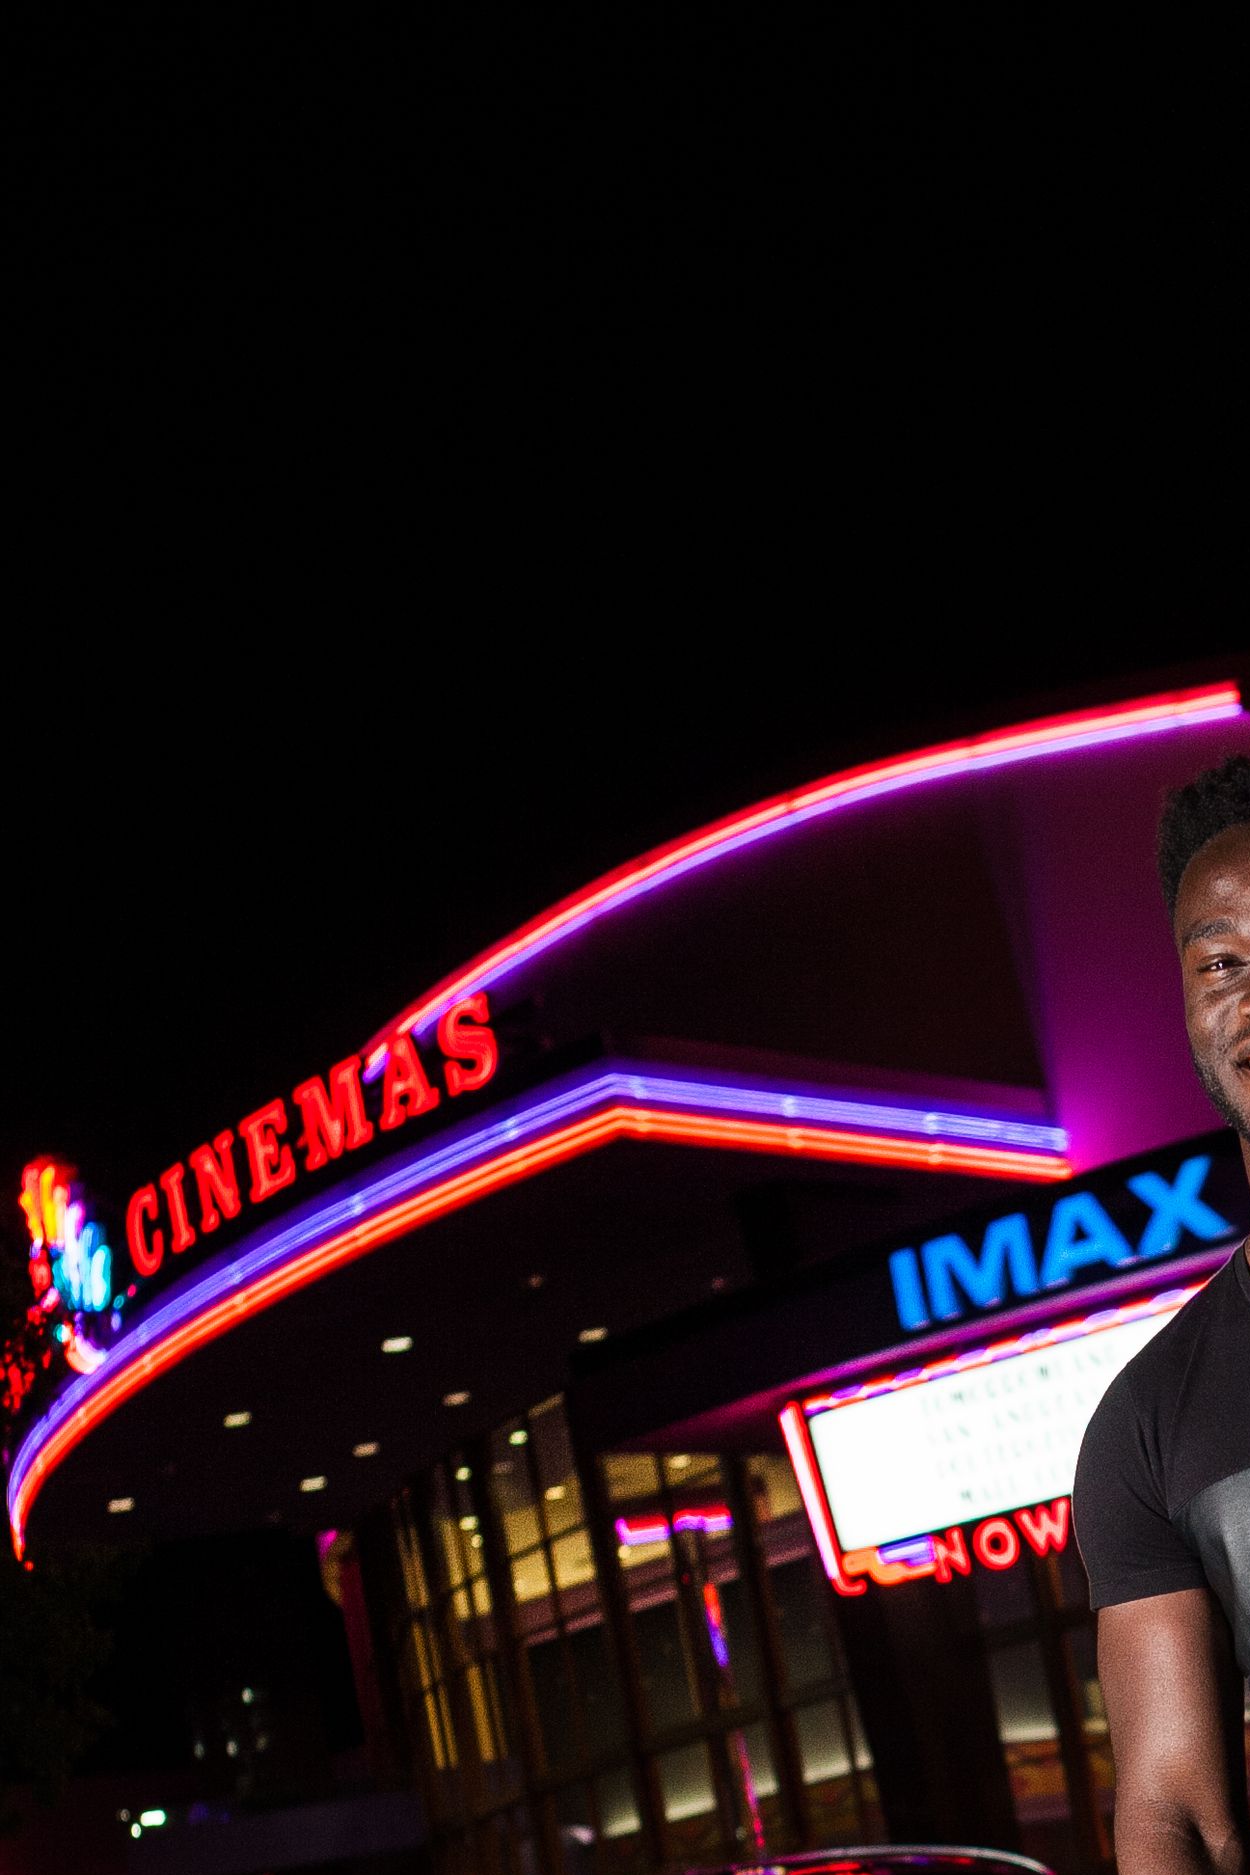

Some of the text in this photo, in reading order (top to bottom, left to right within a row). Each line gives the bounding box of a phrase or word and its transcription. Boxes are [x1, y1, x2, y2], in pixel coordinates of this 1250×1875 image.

[126, 992, 500, 1277] CINEMAS
[889, 1155, 1231, 1332] IMAX
[934, 1496, 1070, 1584] NOW
